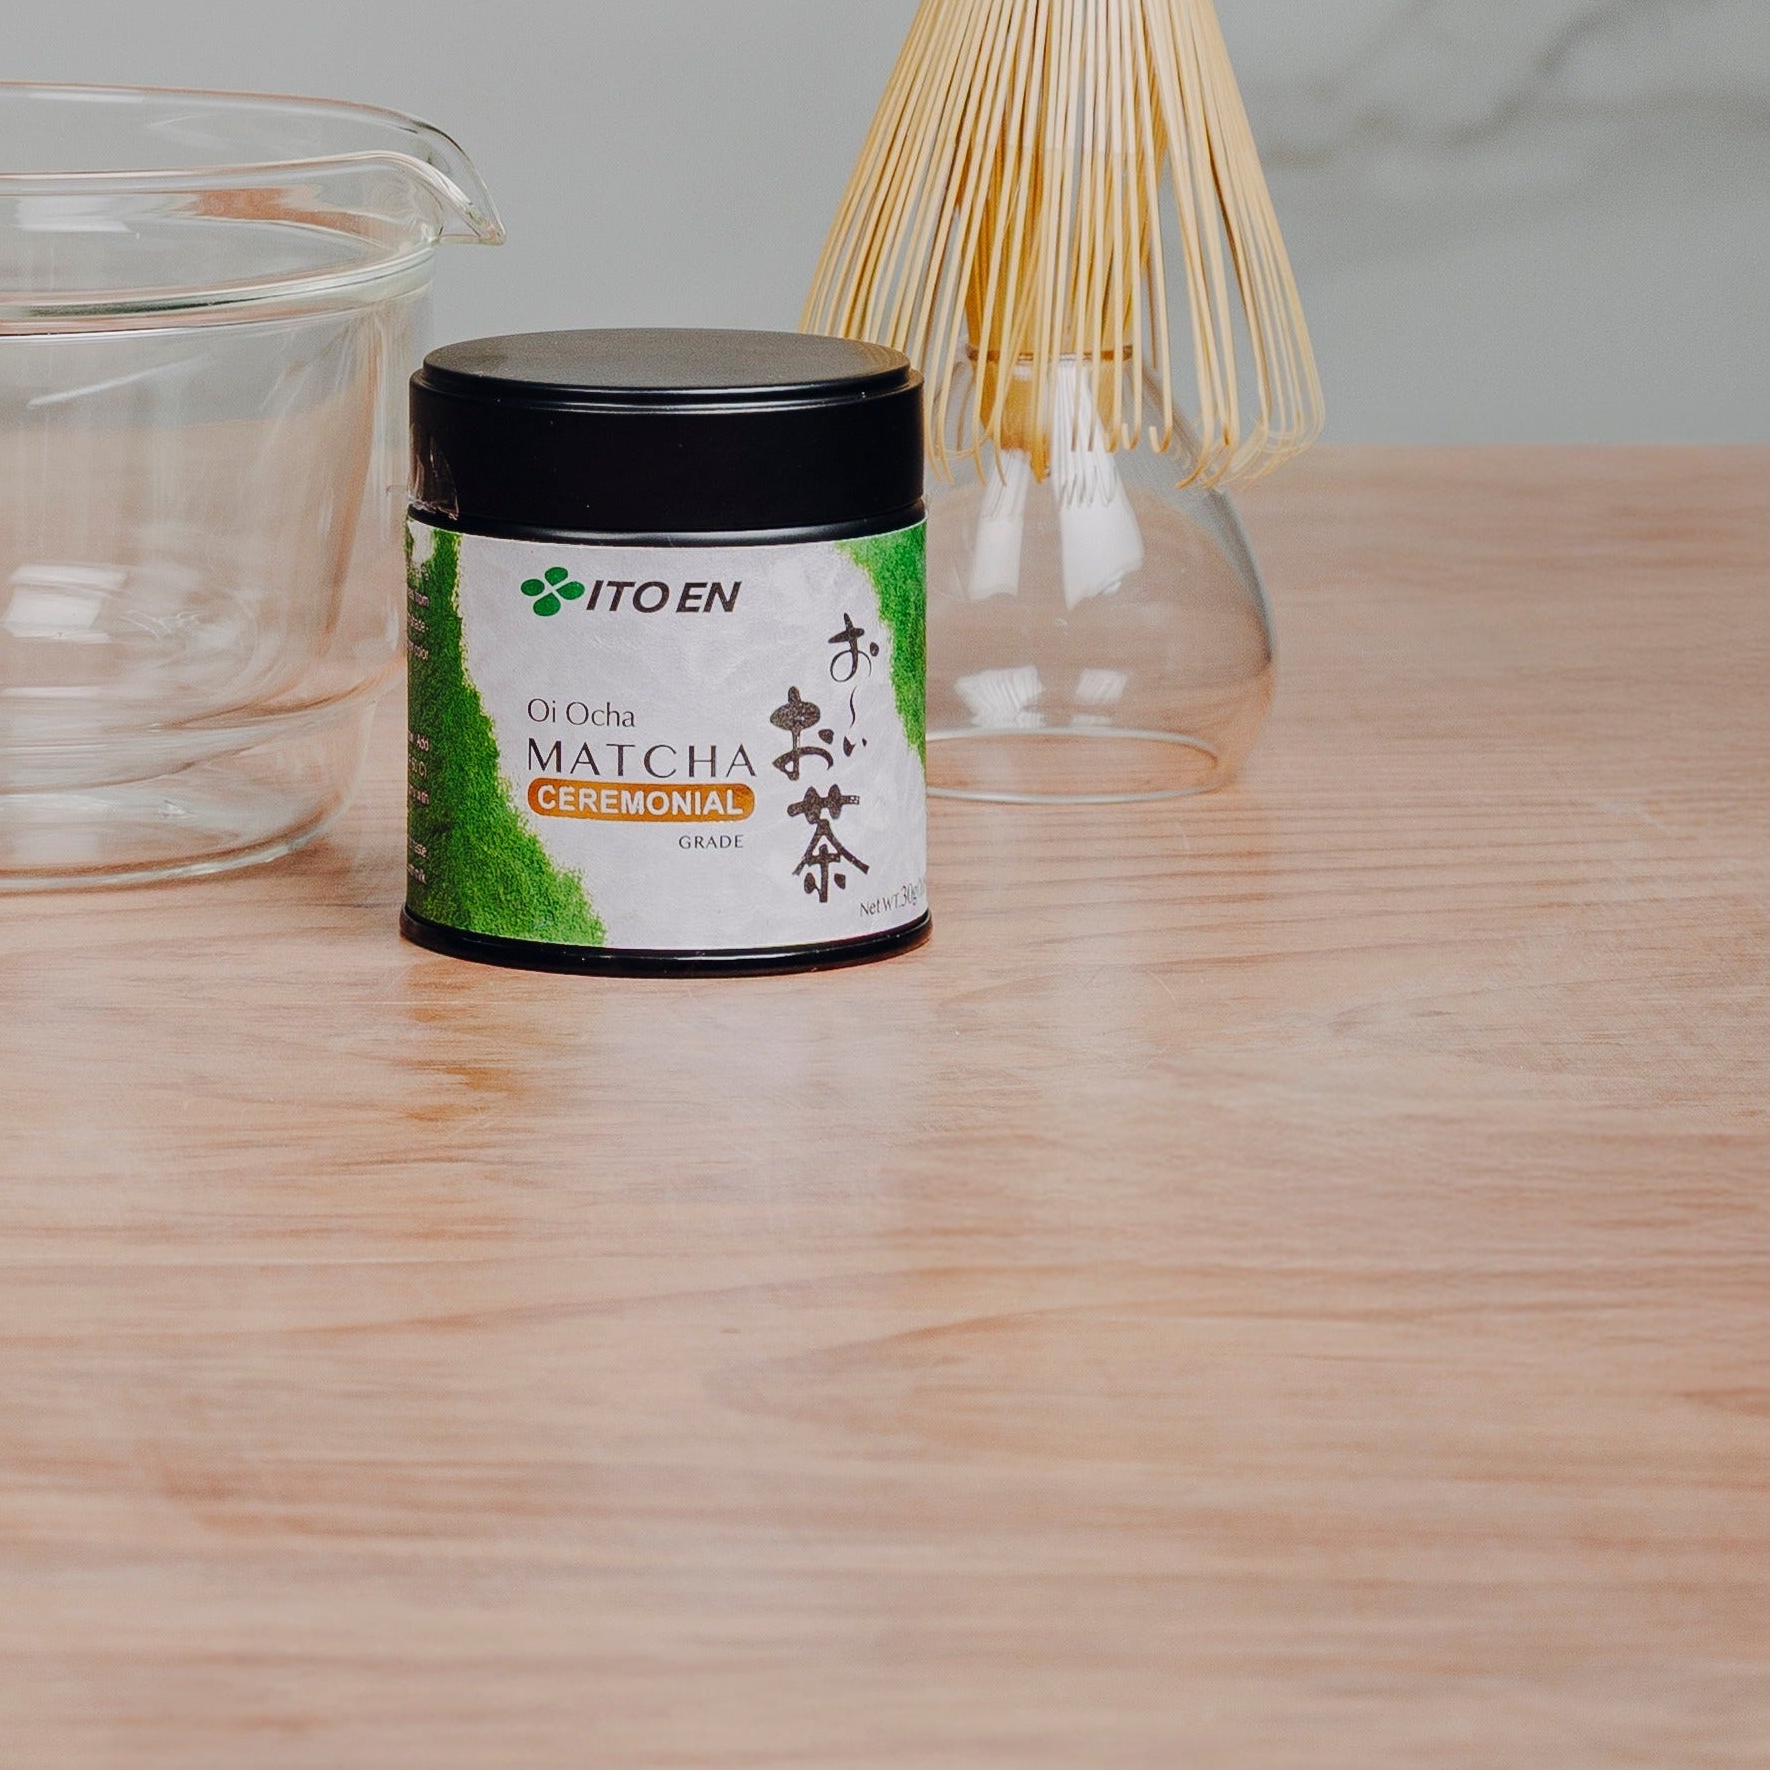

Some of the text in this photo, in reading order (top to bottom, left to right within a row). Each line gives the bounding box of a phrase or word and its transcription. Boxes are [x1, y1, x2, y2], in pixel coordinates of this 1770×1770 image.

[586, 580, 742, 613] ITO EN
[527, 698, 635, 727] Oi Ocha
[528, 738, 757, 778] MATCHA
[537, 784, 744, 816] CEREMONIAL
[679, 834, 744, 849] GRADE
[860, 898, 880, 917] Net
